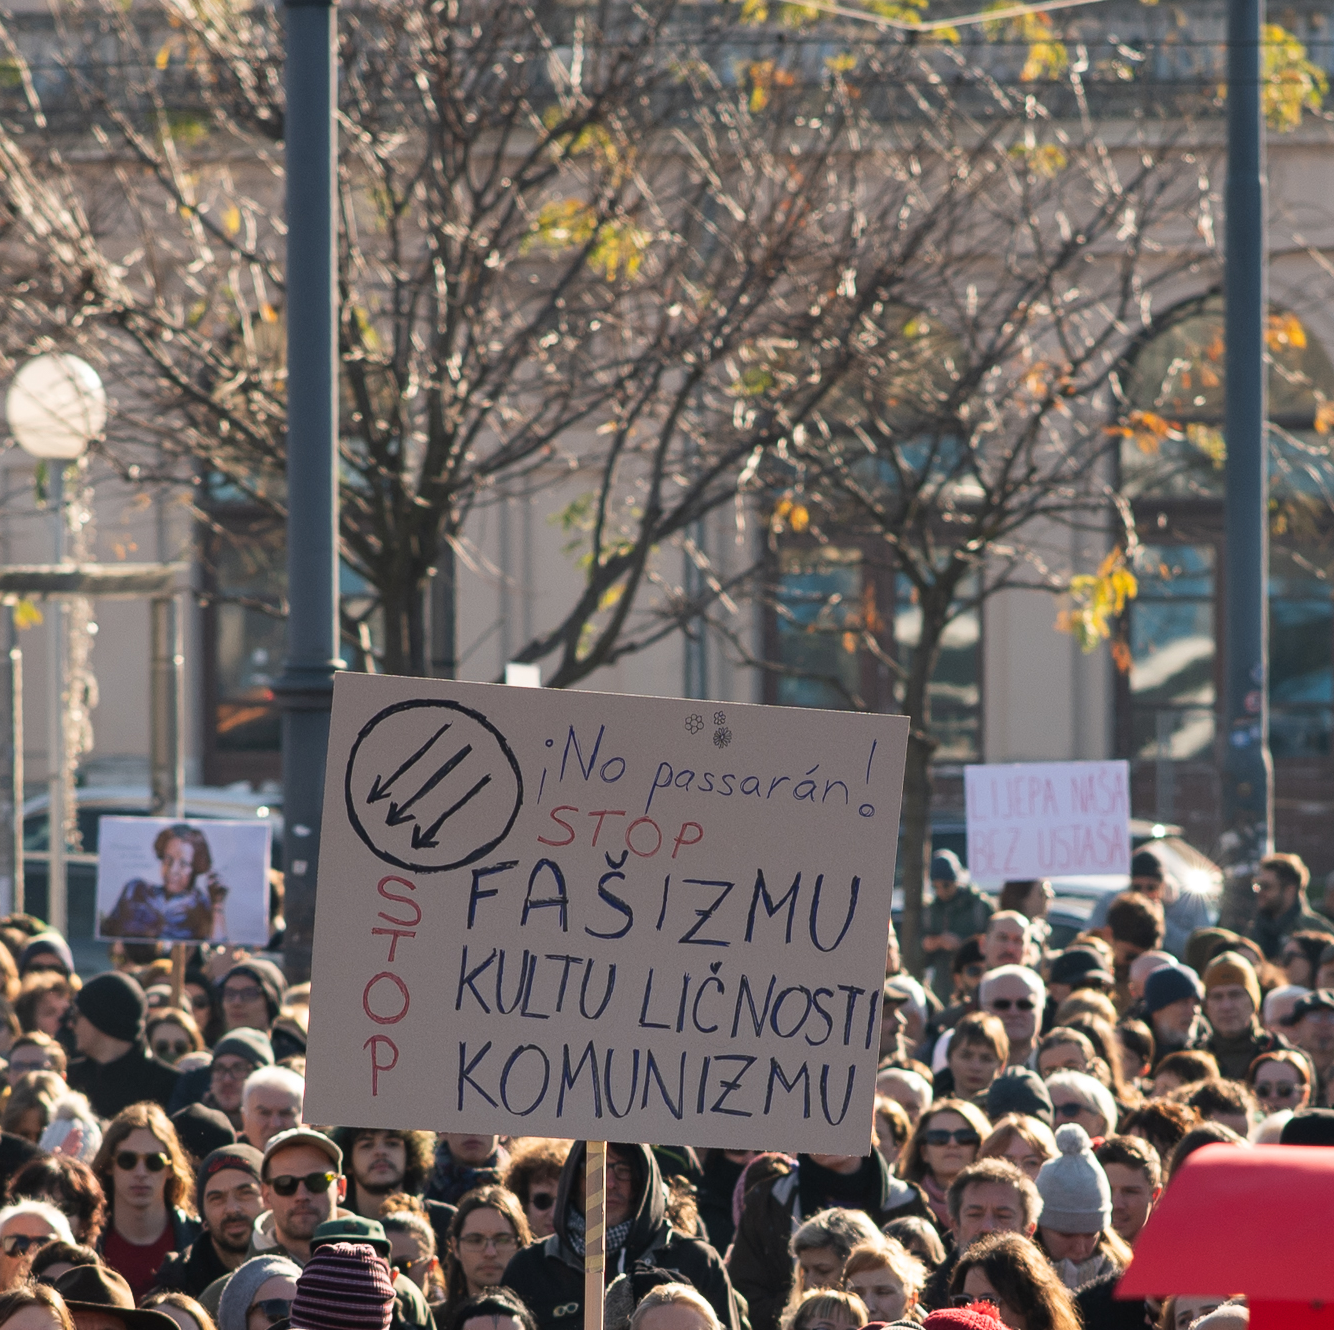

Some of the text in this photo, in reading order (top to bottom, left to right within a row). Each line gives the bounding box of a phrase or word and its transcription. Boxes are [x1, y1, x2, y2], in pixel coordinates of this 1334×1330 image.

[645, 738, 878, 818] passarán!
[537, 805, 704, 858] STOP
[970, 826, 1021, 878] BEZ
[467, 850, 861, 953] FAŠIZMU
[362, 874, 423, 1097] STOP
[455, 945, 879, 1050] KULTU LIČNOSTI
[456, 1040, 856, 1126] KOMUNIZMU
